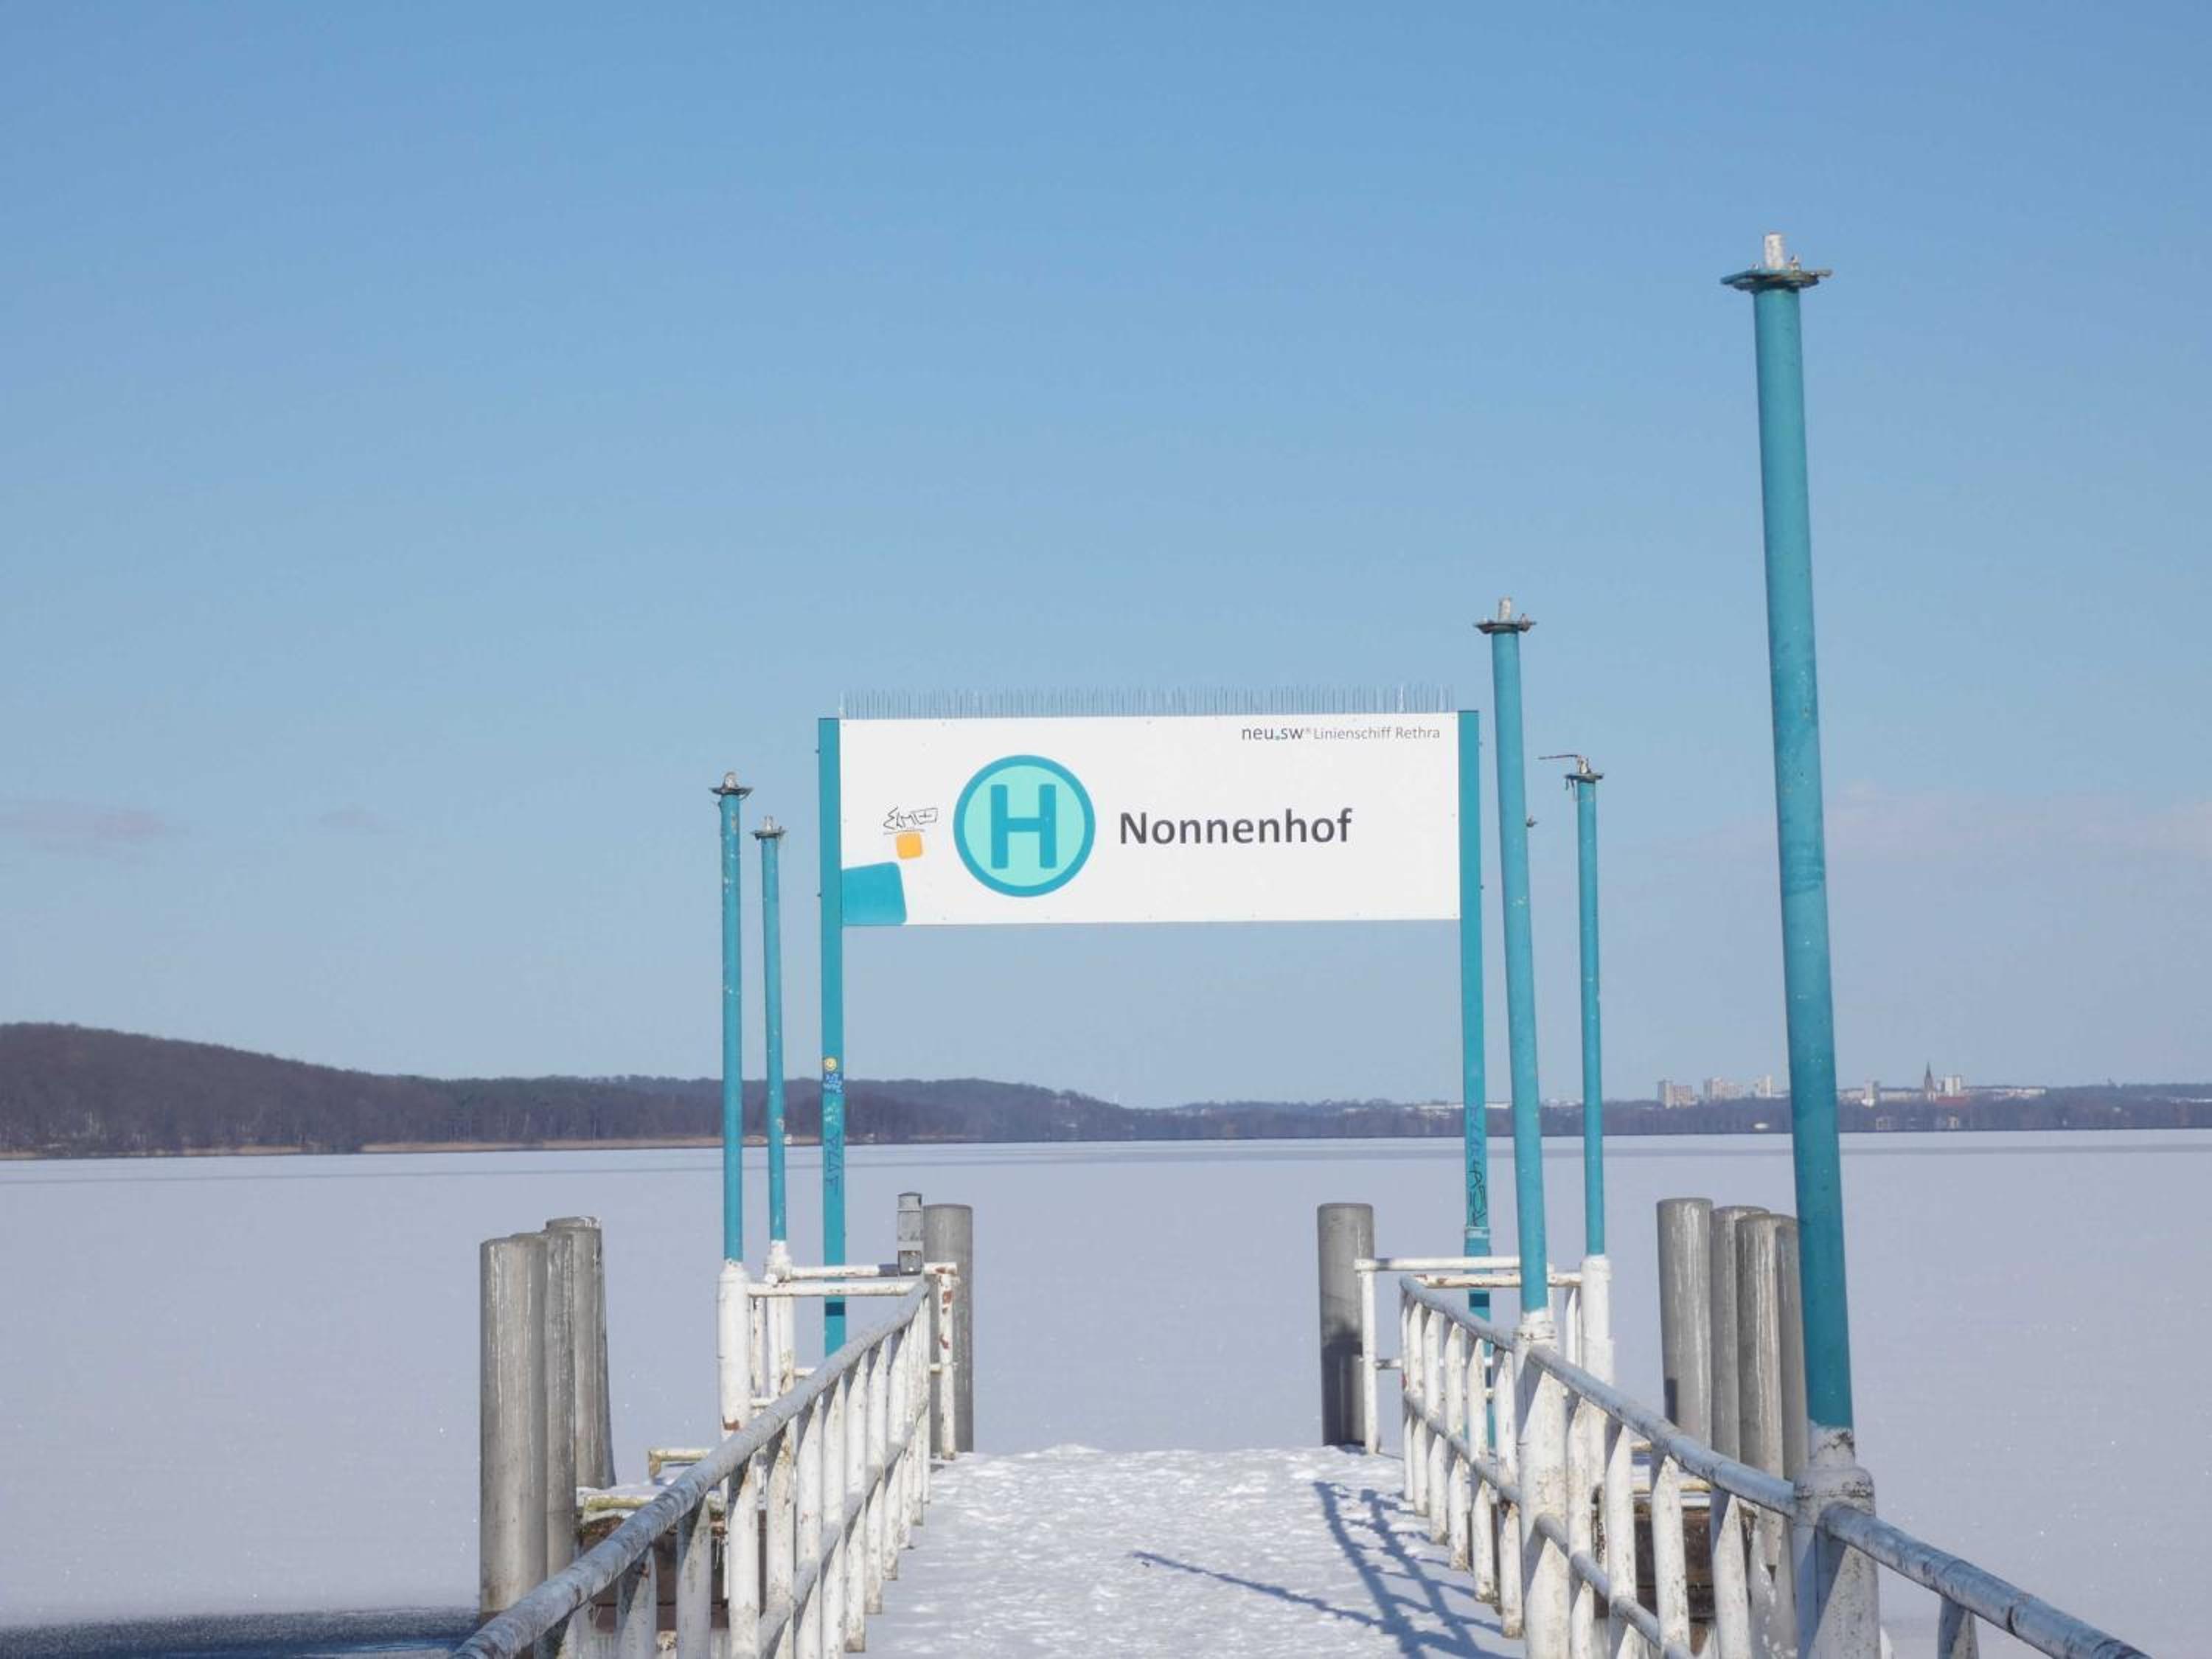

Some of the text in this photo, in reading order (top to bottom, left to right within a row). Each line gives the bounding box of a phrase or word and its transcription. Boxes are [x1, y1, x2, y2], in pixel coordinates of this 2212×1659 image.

[1313, 726, 1391, 740] Linienschiff
[1395, 726, 1440, 740] Rethra
[990, 783, 1057, 869] H
[1119, 807, 1352, 844] Nonnenhof
